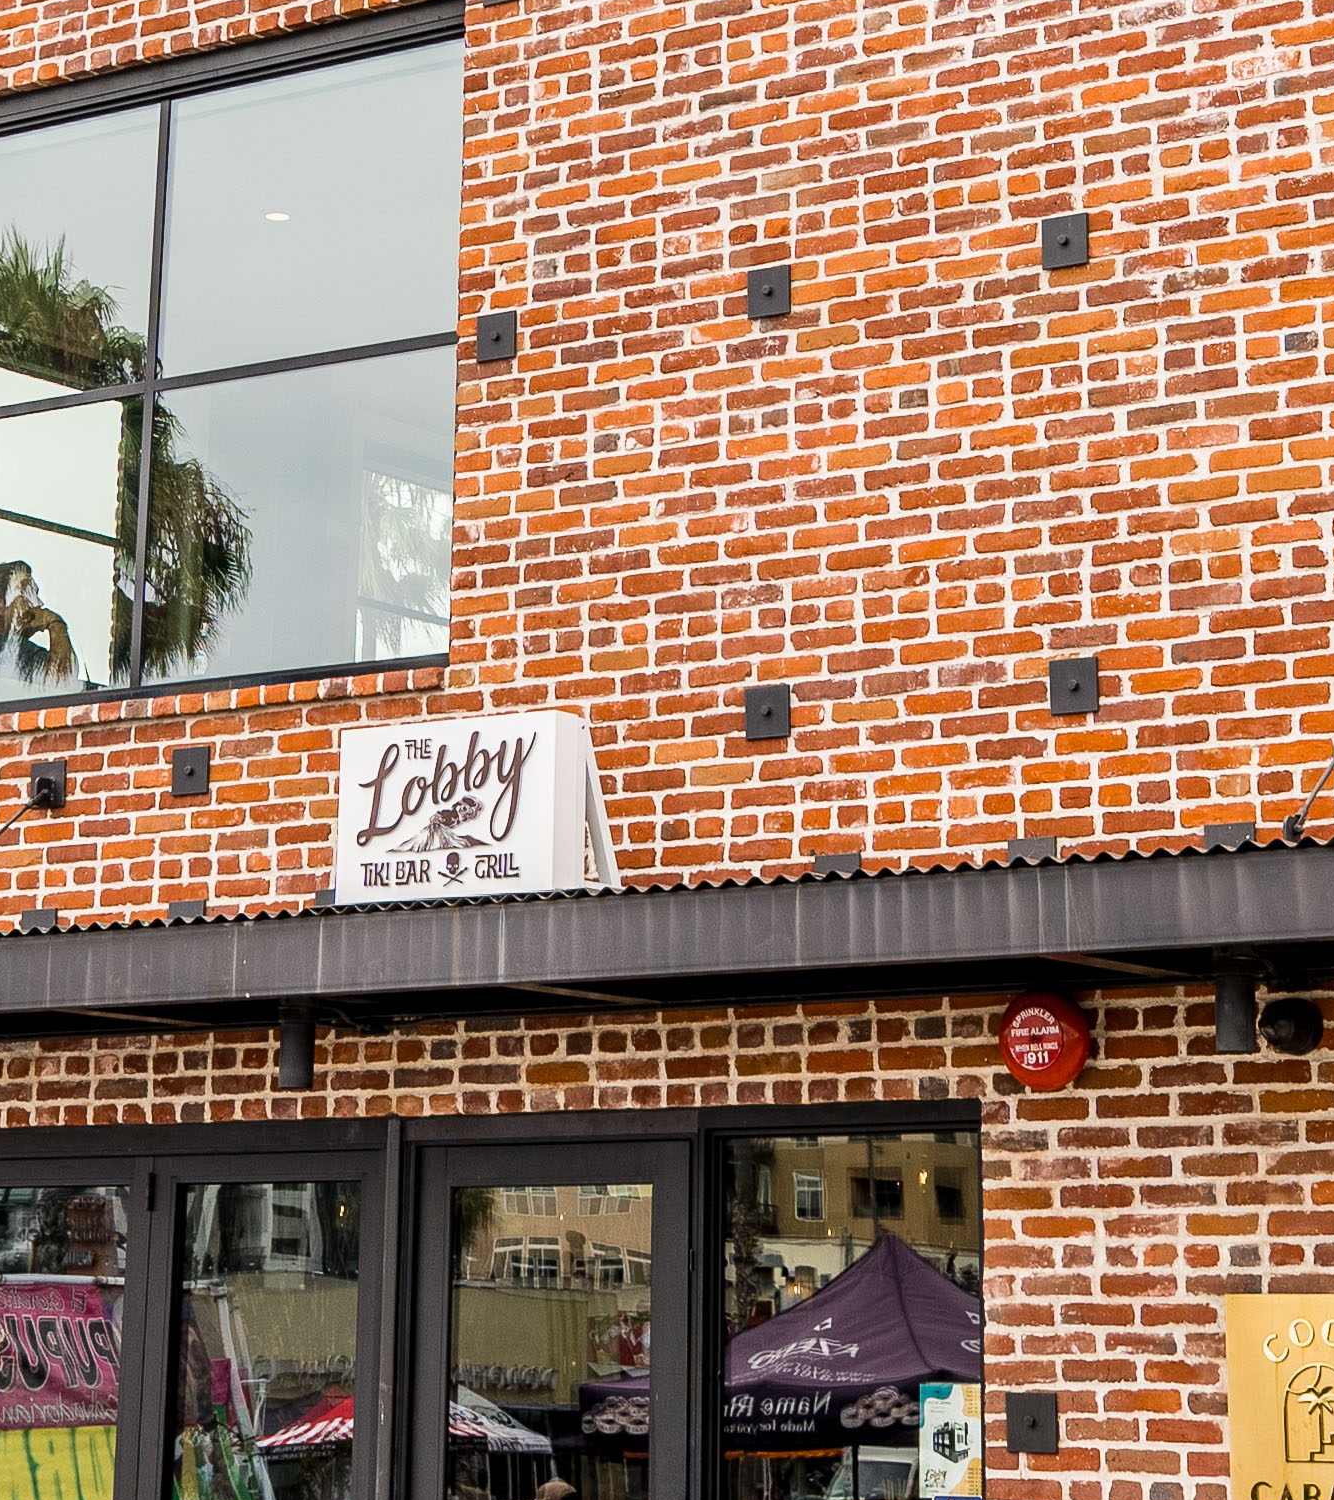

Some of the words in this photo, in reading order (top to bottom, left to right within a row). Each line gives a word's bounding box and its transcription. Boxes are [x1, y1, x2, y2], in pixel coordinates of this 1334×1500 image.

[404, 738, 432, 760] THE
[356, 731, 537, 847] Lobby
[360, 862, 390, 887] TIKI
[395, 858, 431, 885] BAR
[474, 852, 520, 880] GRILL
[1012, 1006, 1056, 1028] SPRINKLER
[1011, 1027, 1030, 1038] FIRE
[1030, 1025, 1059, 1036] ALARM
